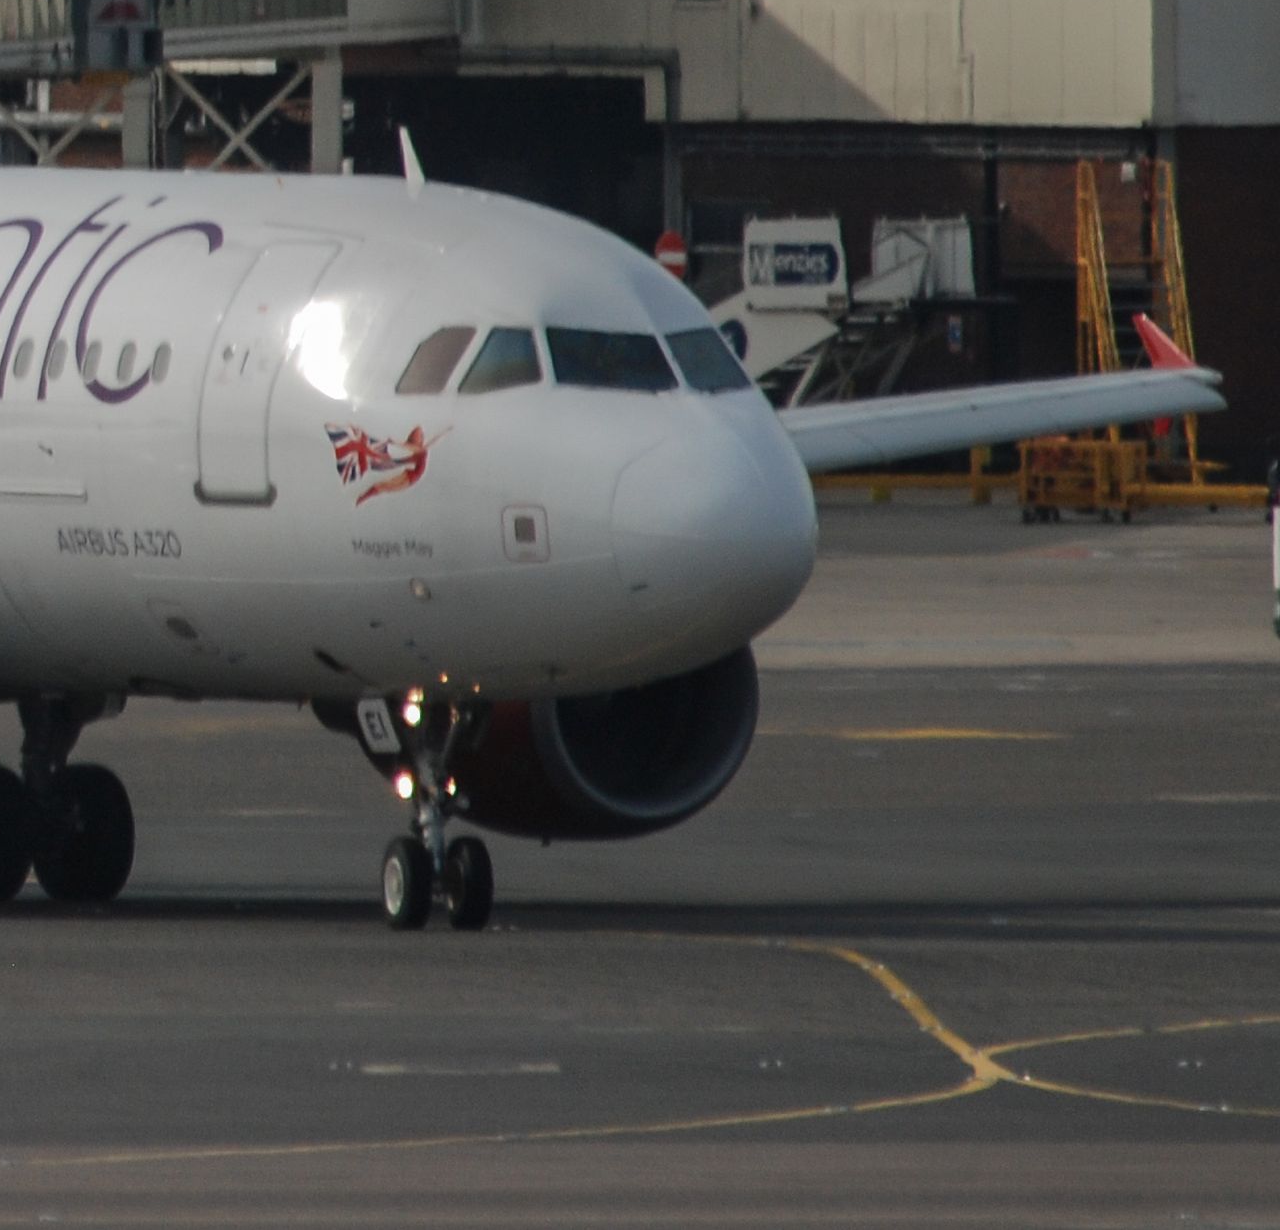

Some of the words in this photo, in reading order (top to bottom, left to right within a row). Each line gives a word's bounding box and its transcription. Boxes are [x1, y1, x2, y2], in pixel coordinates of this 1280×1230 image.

[57, 528, 129, 557] AIRBUS
[134, 530, 182, 558] A320
[351, 538, 401, 559] Maggie
[405, 538, 434, 559] May
